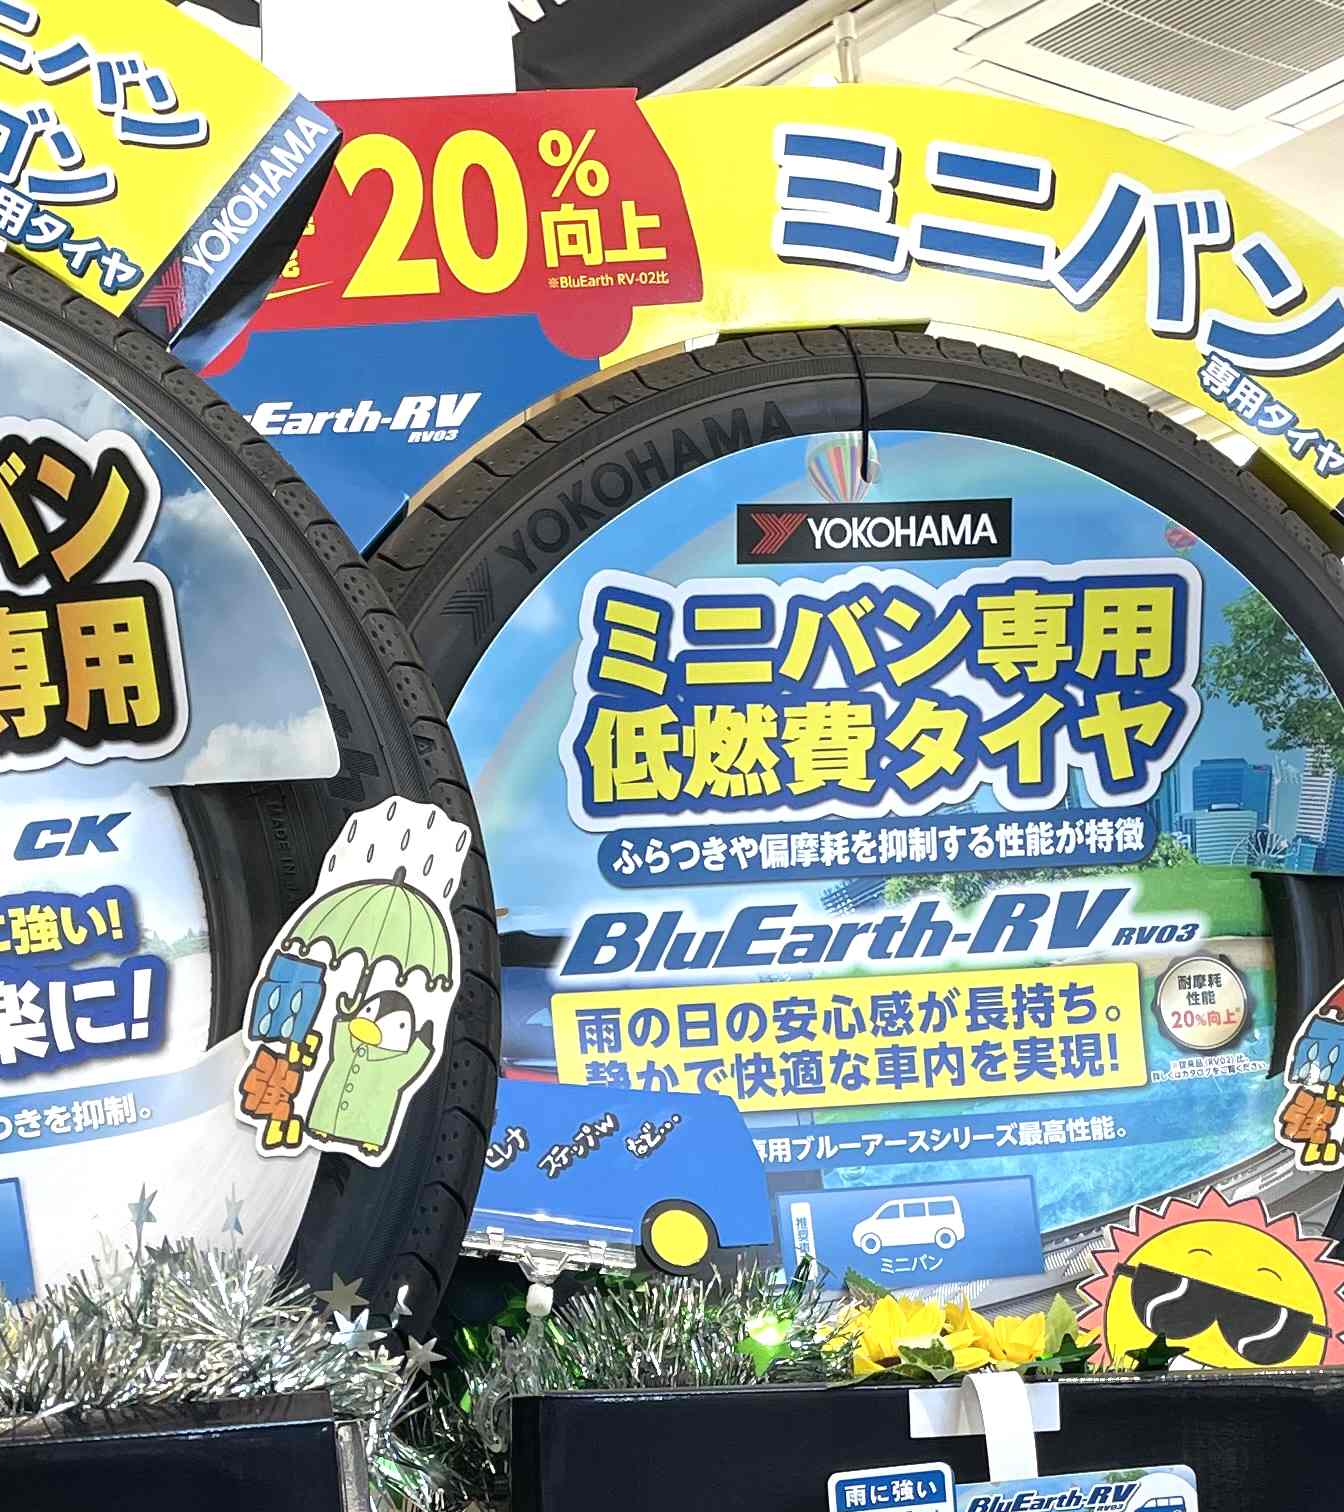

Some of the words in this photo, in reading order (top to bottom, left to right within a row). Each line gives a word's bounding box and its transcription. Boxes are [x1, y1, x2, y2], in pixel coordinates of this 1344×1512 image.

[182, 115, 328, 276] YOKOHAMA
[334, 129, 528, 299] 20
[540, 201, 667, 267] 向上
[408, 429, 459, 444] RV03
[495, 399, 793, 587] YOKOHAMA
[808, 513, 998, 550] YOKOHAMA
[596, 584, 1178, 697] ミニバン専用
[583, 689, 1178, 805] 低燃費タイヤ
[12, 812, 131, 860] CK
[611, 825, 1147, 875] ふらつきや偏摩耗を抑制する性能が特徴
[561, 888, 1132, 976] BluEarth-RV
[1111, 924, 1200, 947] RV03
[1177, 972, 1223, 991] 耐摩耗
[1185, 990, 1217, 1006] 性能
[576, 980, 1123, 1056] 雨の日の安心感が長持ち。
[879, 1253, 944, 1275] ミニバン
[844, 1480, 938, 1509] 雨に強い
